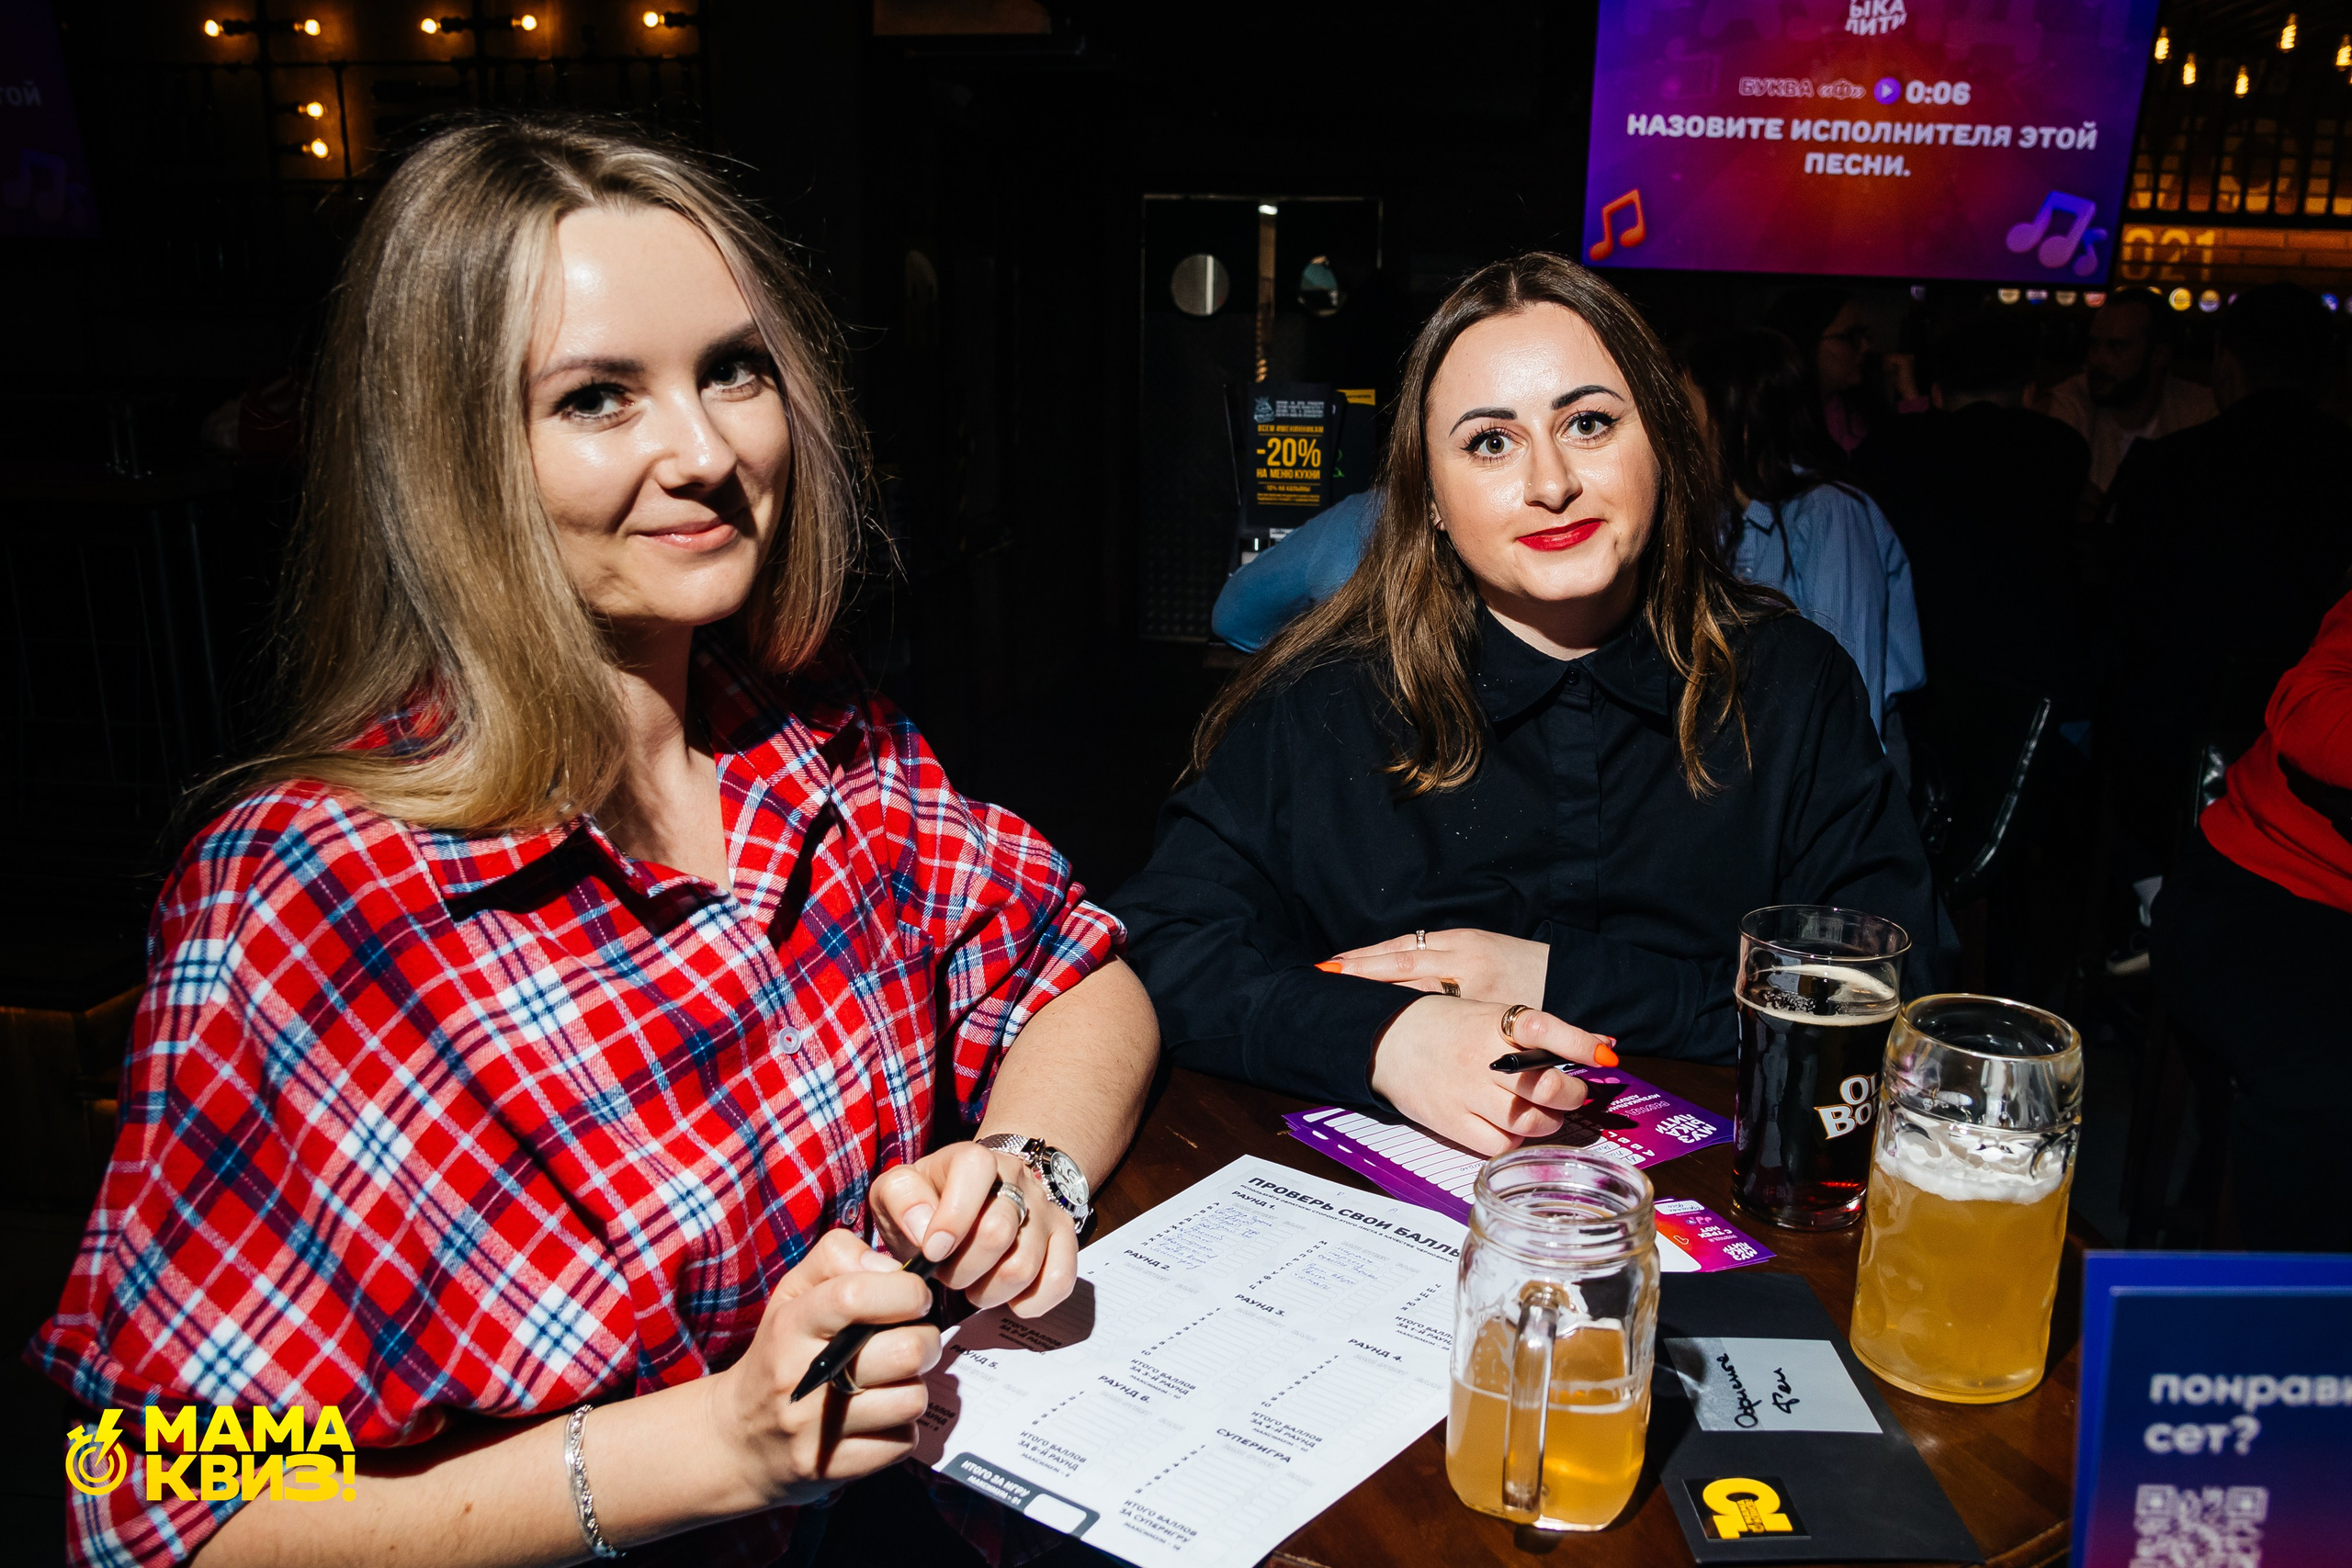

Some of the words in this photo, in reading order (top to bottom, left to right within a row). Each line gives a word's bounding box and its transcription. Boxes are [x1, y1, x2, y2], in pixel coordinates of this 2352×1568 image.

[1739, 76, 1815, 98] БУКВА
[1905, 80, 1972, 106] 0:06
[1626, 113, 1784, 141] НАЗОВИТЕ
[1790, 118, 2012, 148] ИСПОЛНИТЕЛЯ
[2018, 120, 2098, 151] ЭТОЙ
[1804, 152, 1911, 177] ПЕСНИ.
[1256, 437, 1321, 467] -20%
[1256, 468, 1268, 479] НА
[1294, 469, 1321, 479] КУХНИ
[1678, 1123, 1717, 1144] МУЗ
[1630, 1143, 1644, 1151] Б
[1230, 1190, 1267, 1207] РАУНД
[1247, 1177, 1334, 1211] ПРОВЕРЬ
[1337, 1208, 1393, 1230] СВОИ
[1123, 1249, 1160, 1267] РАУНД
[1234, 1293, 1274, 1313] РАУНД
[1425, 1326, 1453, 1339] БАЛЛ
[950, 1344, 989, 1365] РАУНД
[1347, 1338, 1390, 1358] РАУНД
[1097, 1375, 1139, 1398] РАУНД
[1130, 1359, 1159, 1373] ИТОГО
[1157, 1371, 1196, 1390] БАЛЛОВ
[1250, 1411, 1283, 1426] ИТОГО
[1281, 1424, 1322, 1442] БАЛЛОВ
[2143, 1415, 2261, 1455] сет?
[1019, 1430, 1049, 1446] ИТОГО
[1046, 1443, 1087, 1463] БАЛЛОВ
[1216, 1428, 1291, 1462] СУПЕРИГРА
[960, 1460, 992, 1480] ИТОГО
[989, 1474, 1005, 1486] ЗА
[1002, 1480, 1030, 1497] ИГРУ
[1124, 1499, 1156, 1517] ИТОГО
